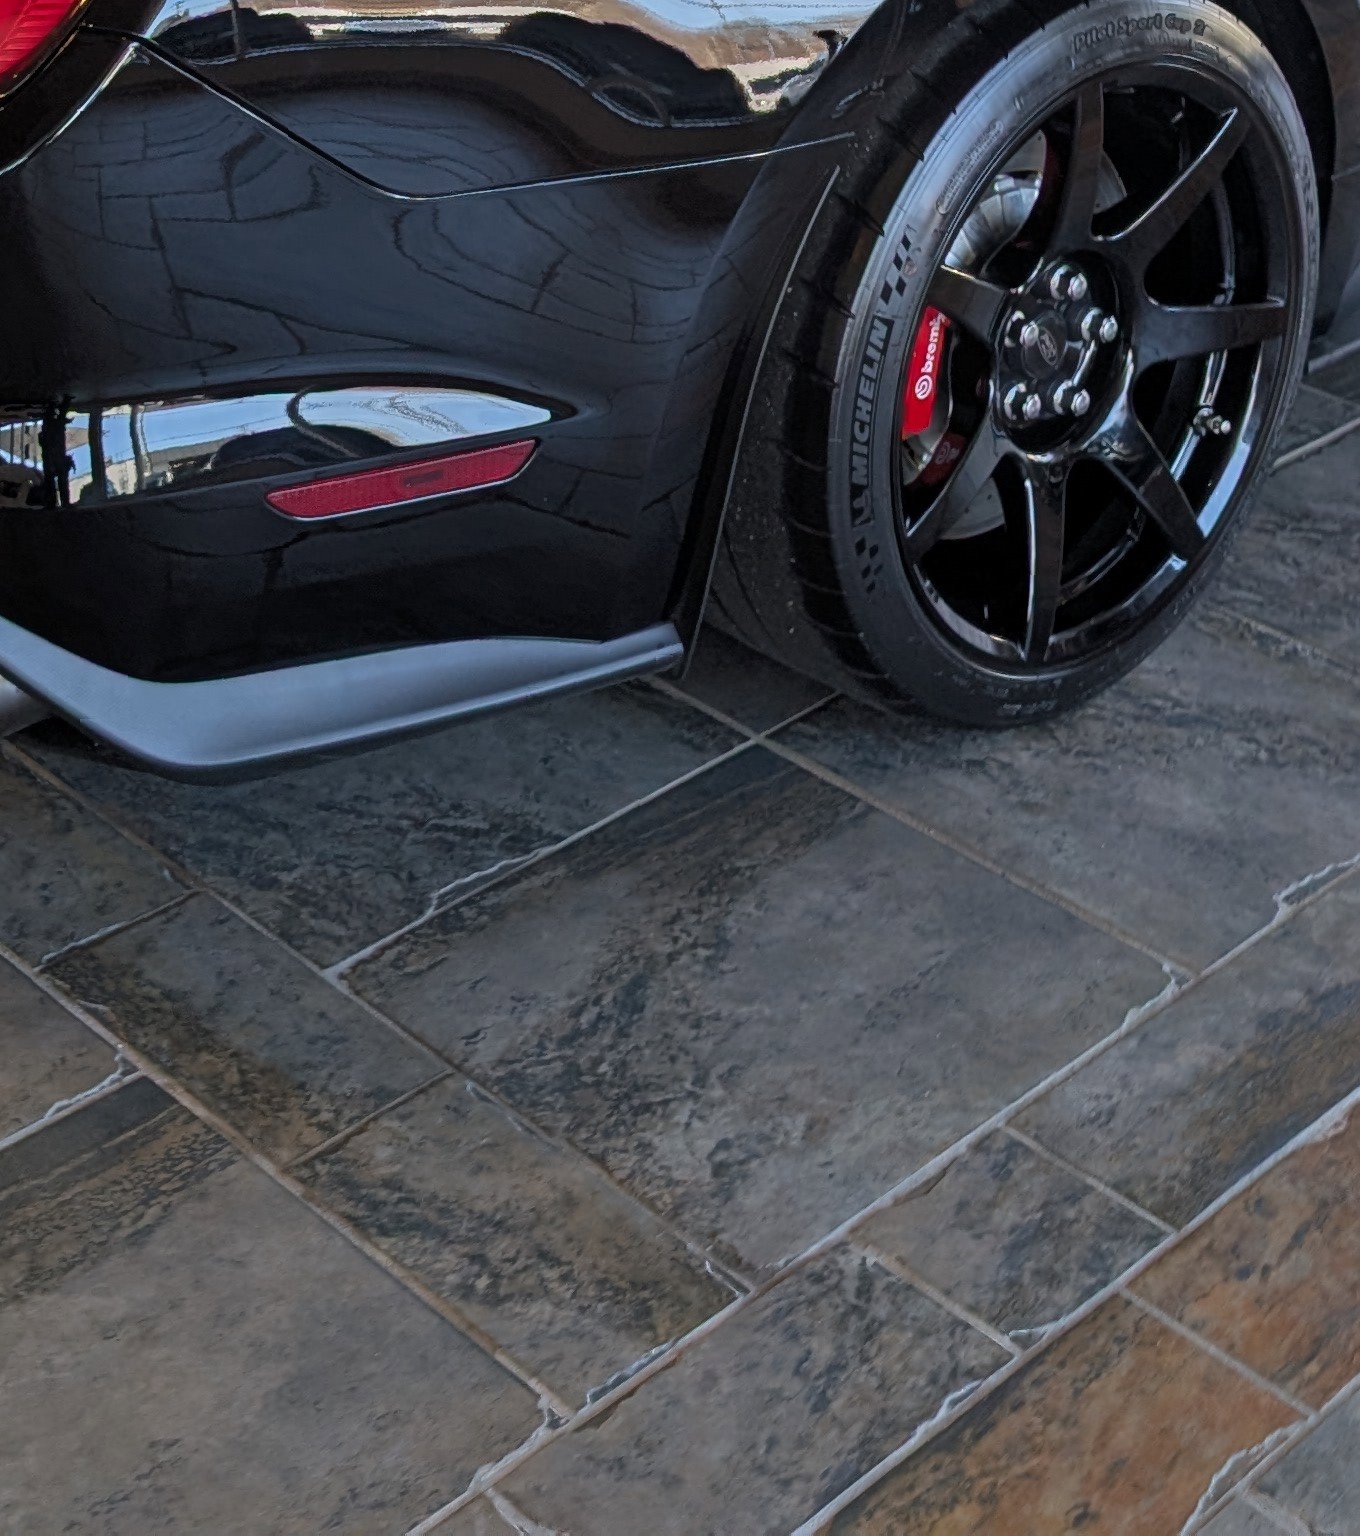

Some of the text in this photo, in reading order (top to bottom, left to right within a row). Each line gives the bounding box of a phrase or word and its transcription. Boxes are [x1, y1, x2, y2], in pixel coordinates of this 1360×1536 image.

[1117, 13, 1163, 37] Sport
[1164, 13, 1191, 34] Cup
[851, 318, 889, 486] MICHELIN
